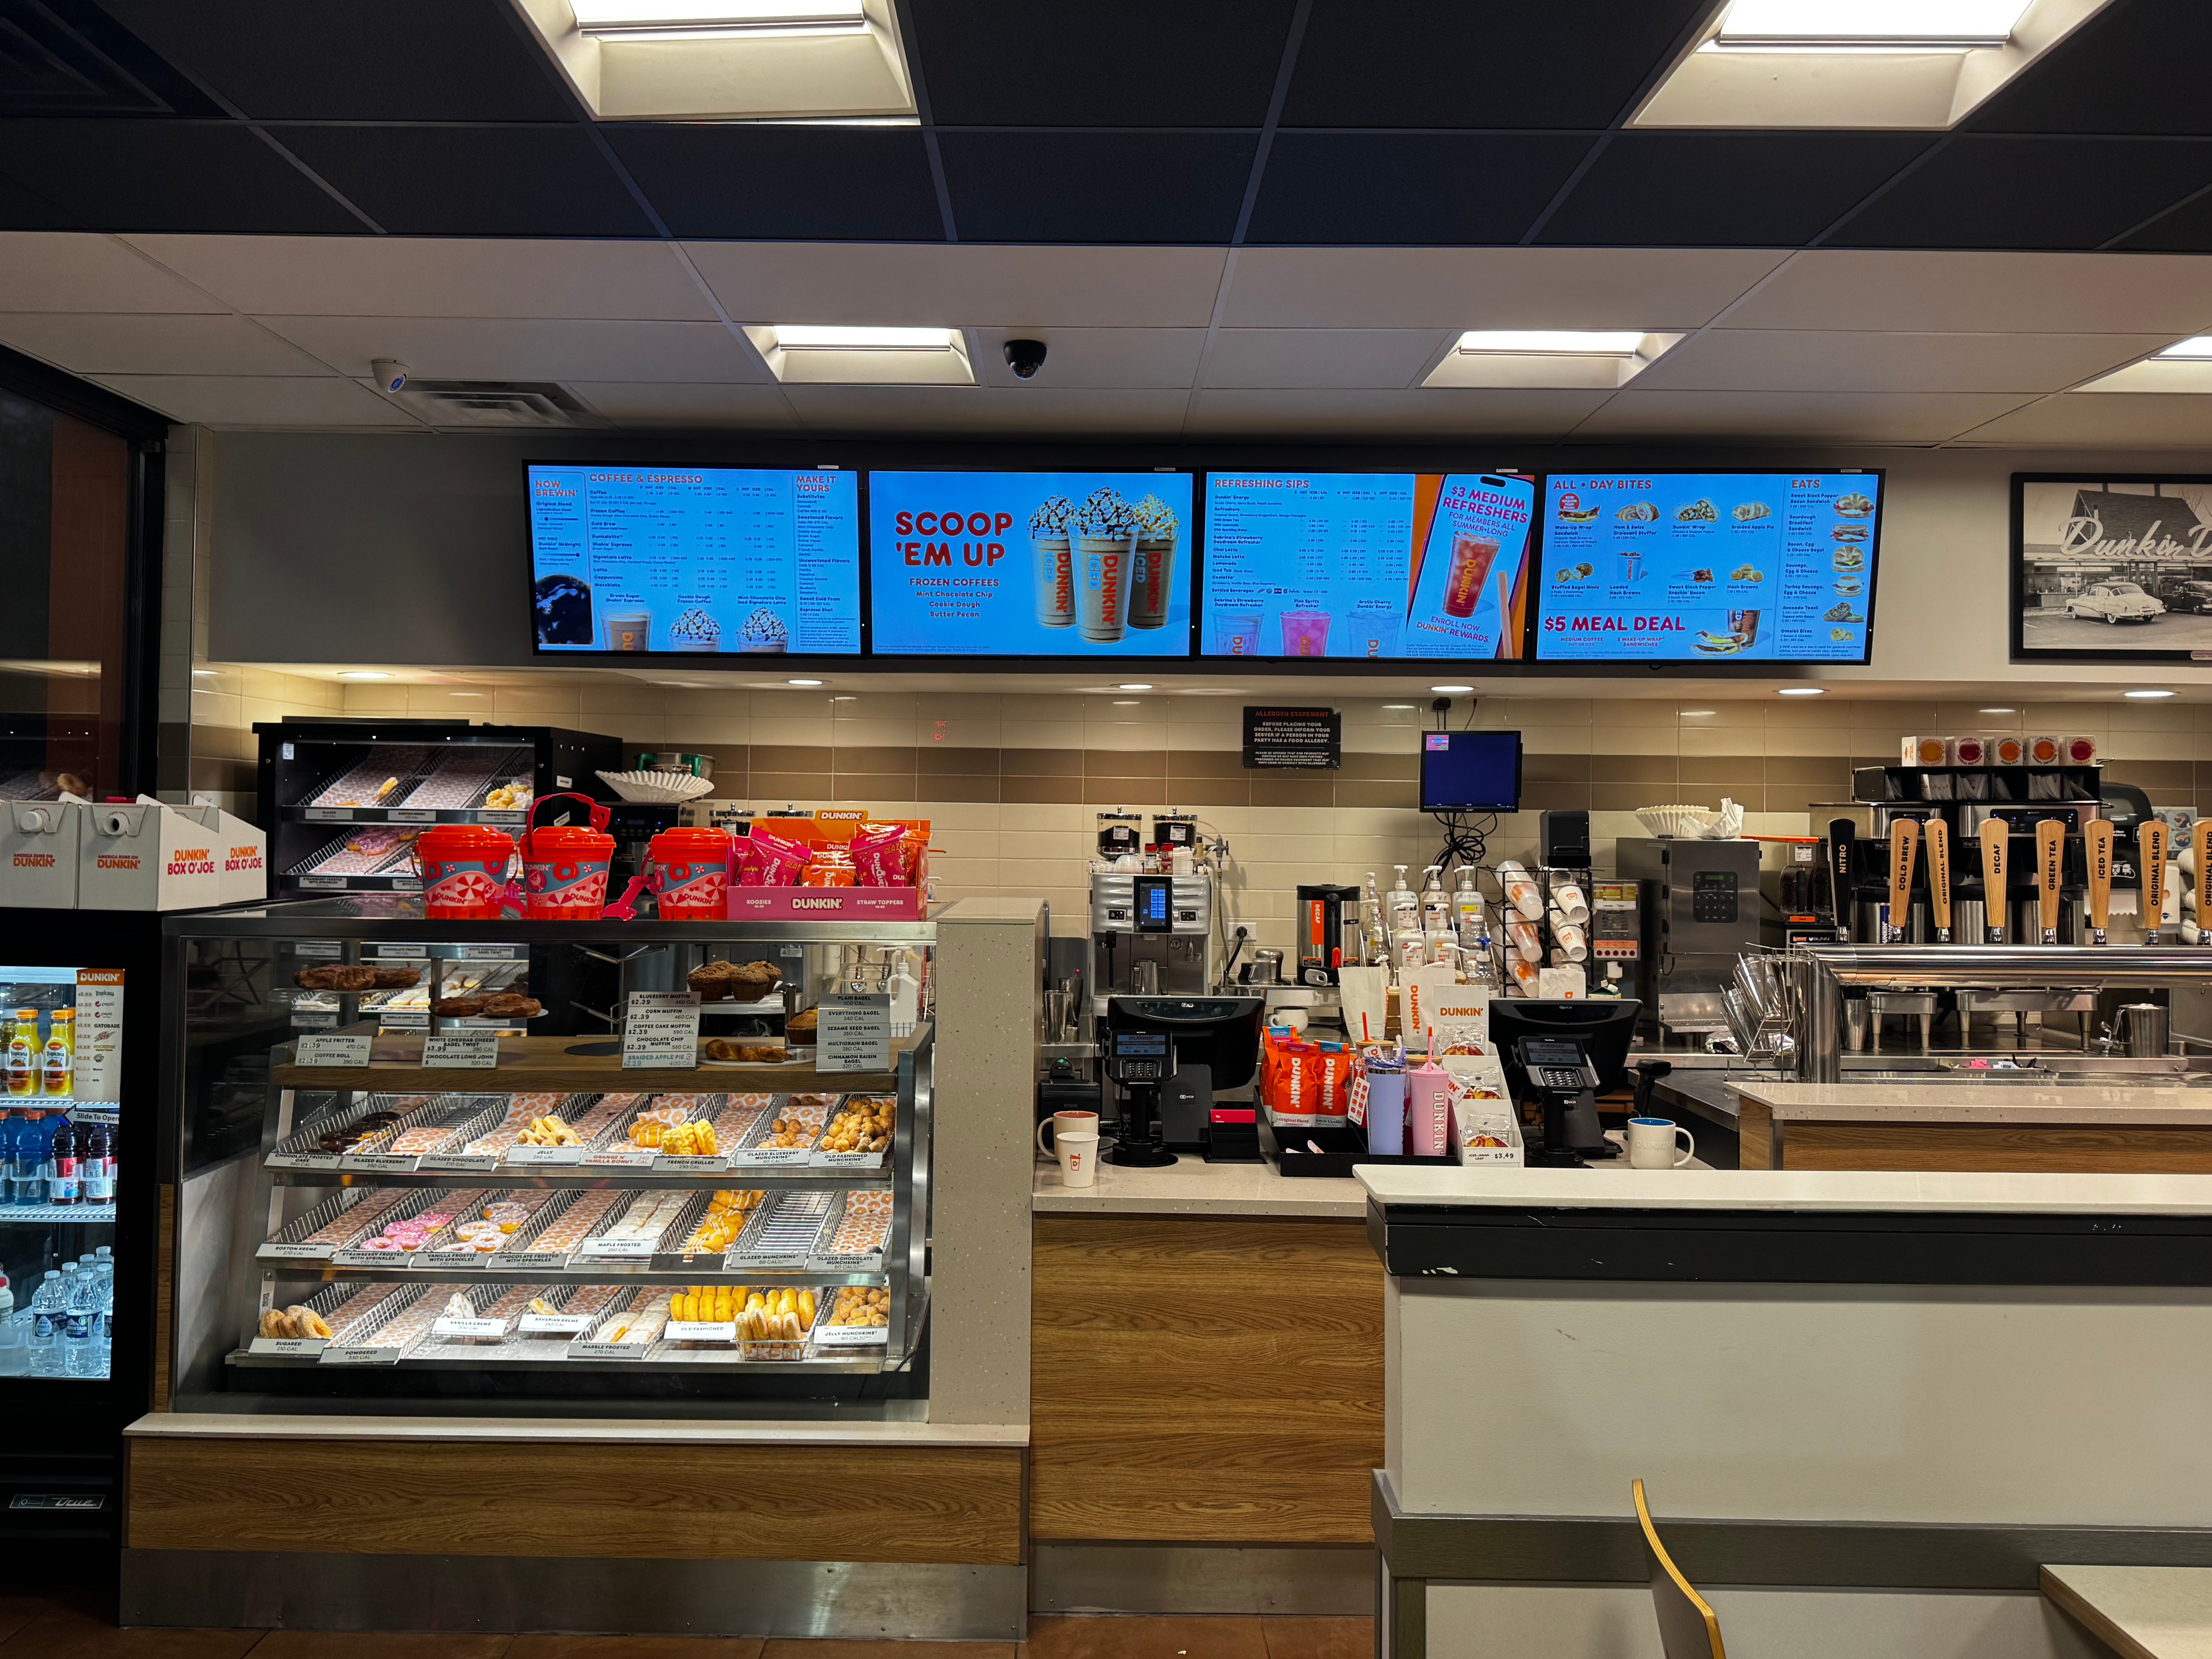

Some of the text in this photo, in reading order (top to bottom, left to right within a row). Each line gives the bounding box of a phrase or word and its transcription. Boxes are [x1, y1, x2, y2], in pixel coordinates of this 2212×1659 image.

[590, 474, 632, 482] COFFEE
[647, 475, 703, 483] ESPRESSO
[1215, 479, 1283, 488] REFRESHING
[1554, 480, 1651, 489] ALL DAY BITES
[1792, 480, 1820, 488] EATS
[1452, 486, 1525, 510] $3 MEDIUM
[1443, 497, 1528, 523] REFRESHERS
[896, 512, 1012, 536] SCOOP
[1465, 515, 1500, 528] MEMBERS
[1502, 522, 1515, 531] ALL
[896, 542, 1005, 566] 'EM UP
[1044, 552, 1054, 582] ICED
[910, 579, 999, 587] FROZEN COFFEES
[1136, 553, 1162, 613] ICED DUNKIN'
[1088, 555, 1118, 626] ICED DUNKIN'
[1417, 622, 1449, 634] DUNKIN'
[1431, 617, 1480, 631] ENROLL NOW
[1544, 616, 1685, 632] $5 MEAL DEAL
[821, 811, 863, 820] DUNKIN'
[174, 848, 209, 861] DUNKIN'
[230, 846, 257, 858] DUNKIN'
[1901, 836, 1910, 861] BREW
[97, 859, 140, 869] DUNKIN'
[168, 862, 186, 875] BOX
[225, 859, 240, 871] BOX
[792, 897, 843, 910] DUNKIN'
[80, 973, 119, 982] DUNKIN'
[1410, 985, 1420, 1035] DUNKIN'
[1440, 1008, 1483, 1016] DUNKIN'
[1290, 1058, 1300, 1108] DUNKIN'
[1323, 1059, 1335, 1109] DUNKIN'
[1433, 1091, 1444, 1154] DUNKIN'
